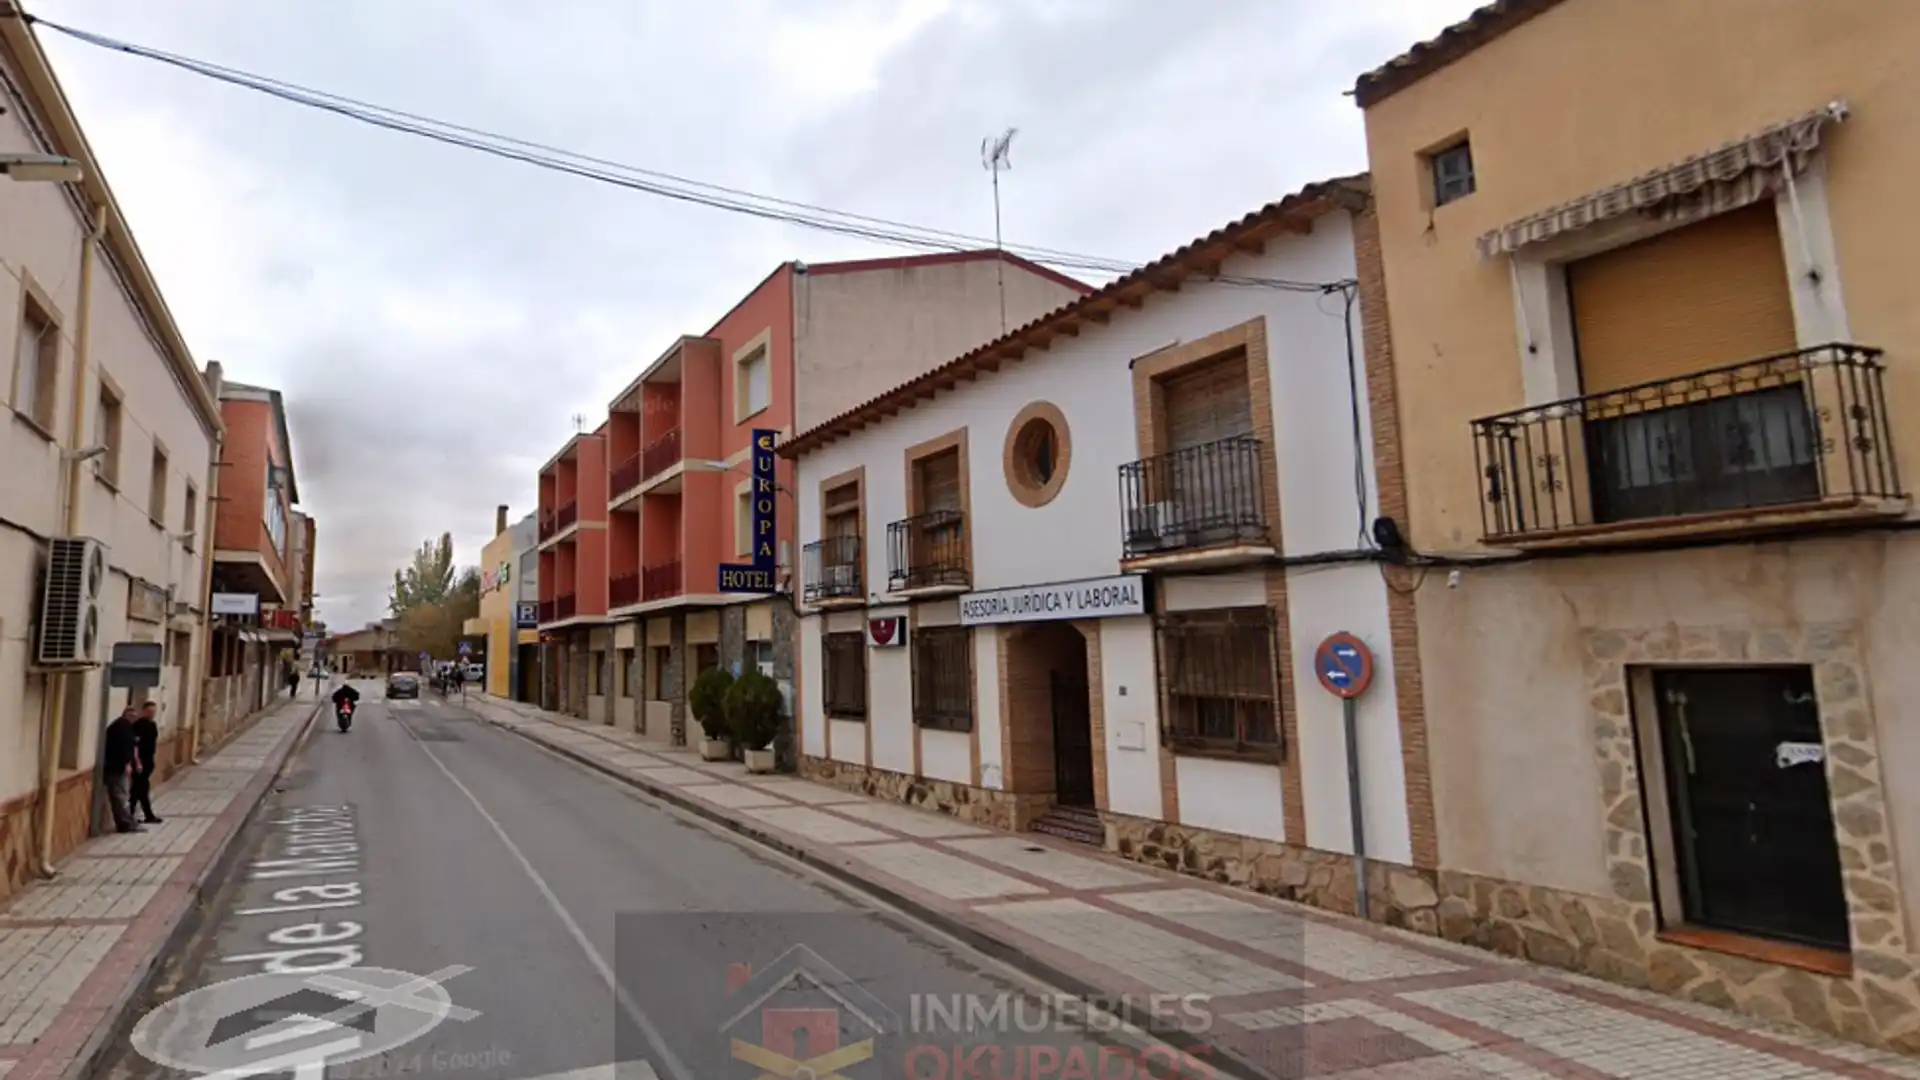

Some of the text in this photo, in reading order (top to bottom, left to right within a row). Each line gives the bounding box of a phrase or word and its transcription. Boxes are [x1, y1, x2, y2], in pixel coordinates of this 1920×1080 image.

[722, 569, 773, 588] HOTEL
[1064, 590, 1074, 609] Y
[1077, 584, 1139, 610] LABORAL
